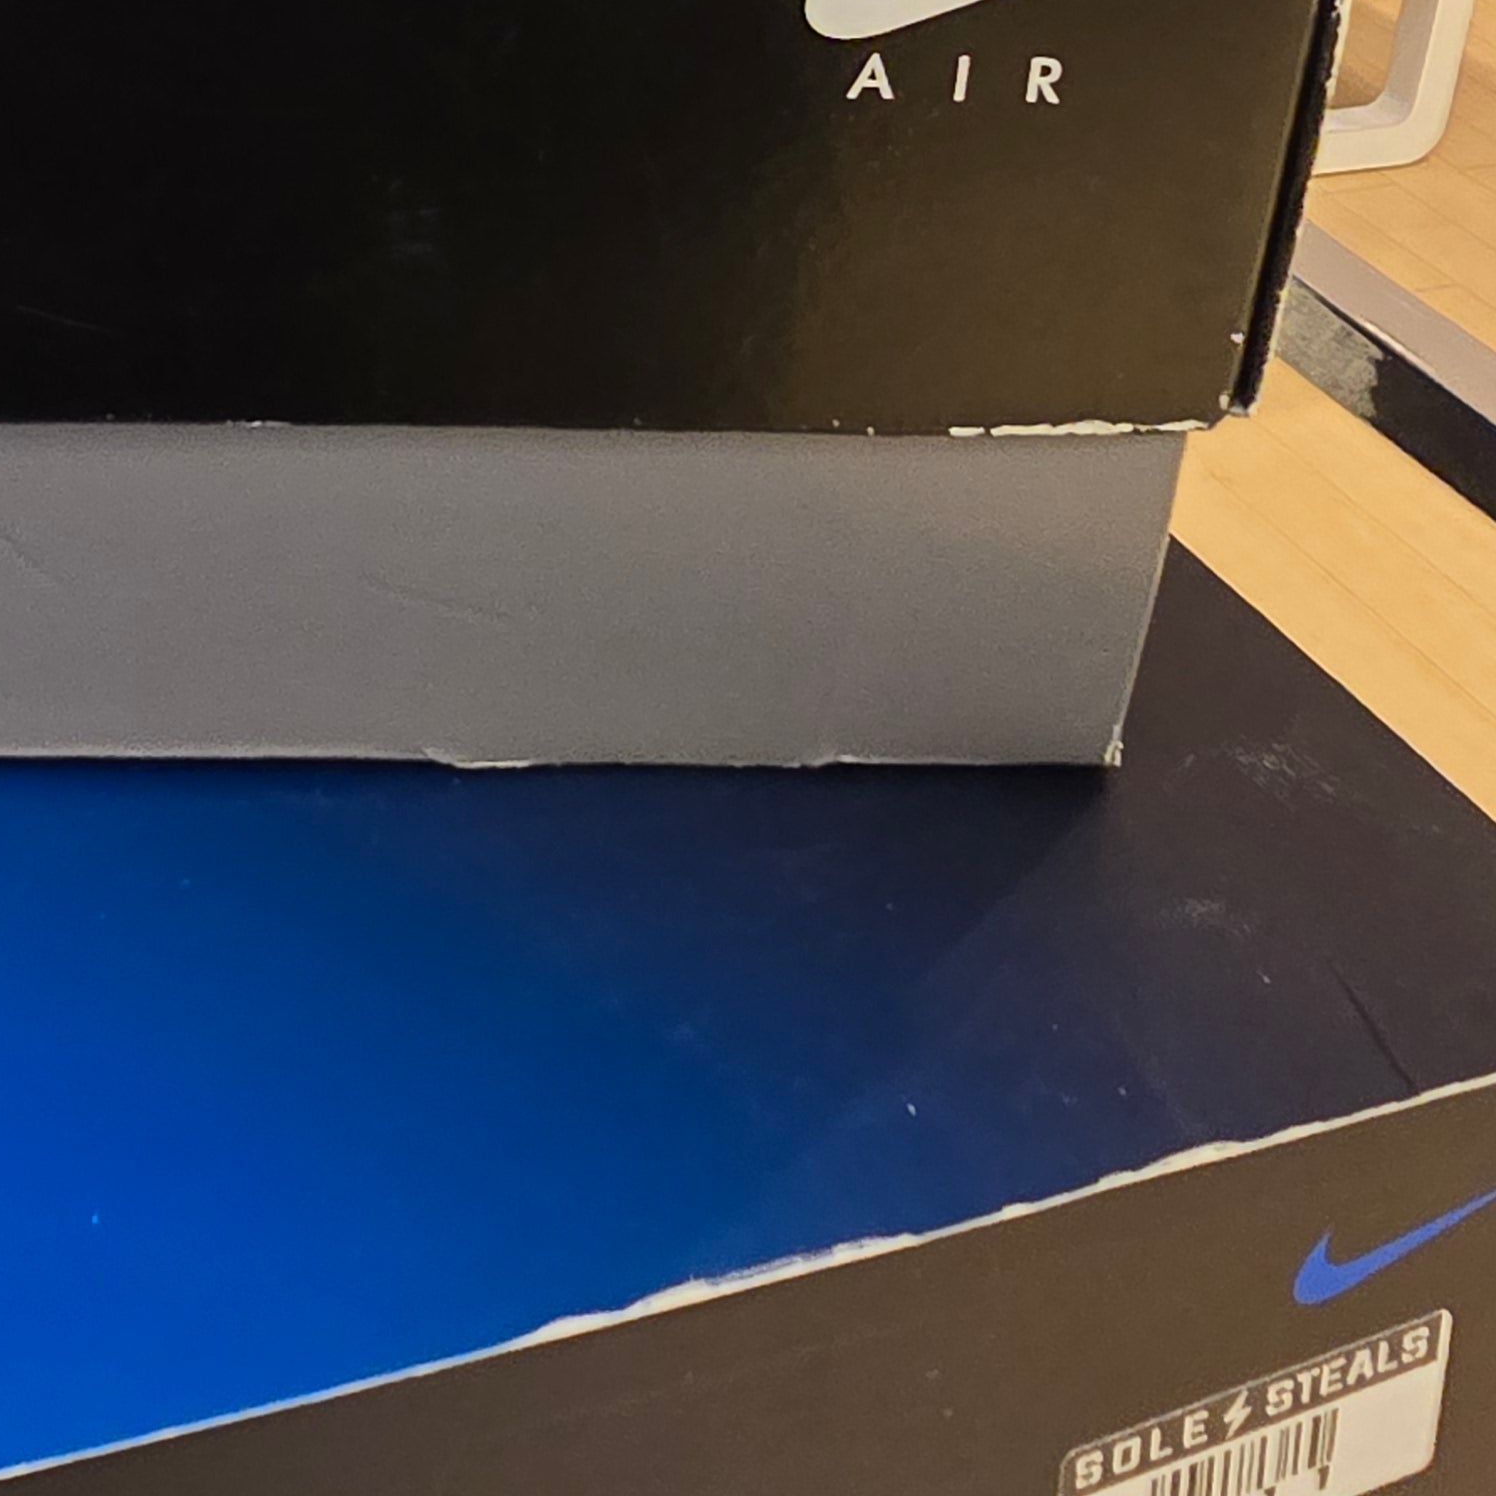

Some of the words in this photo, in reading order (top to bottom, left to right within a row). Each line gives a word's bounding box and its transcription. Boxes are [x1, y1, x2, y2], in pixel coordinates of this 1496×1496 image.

[845, 52, 1064, 104] AIR
[1074, 1409, 1210, 1491] SOLE
[1265, 1325, 1431, 1417] STEALS
